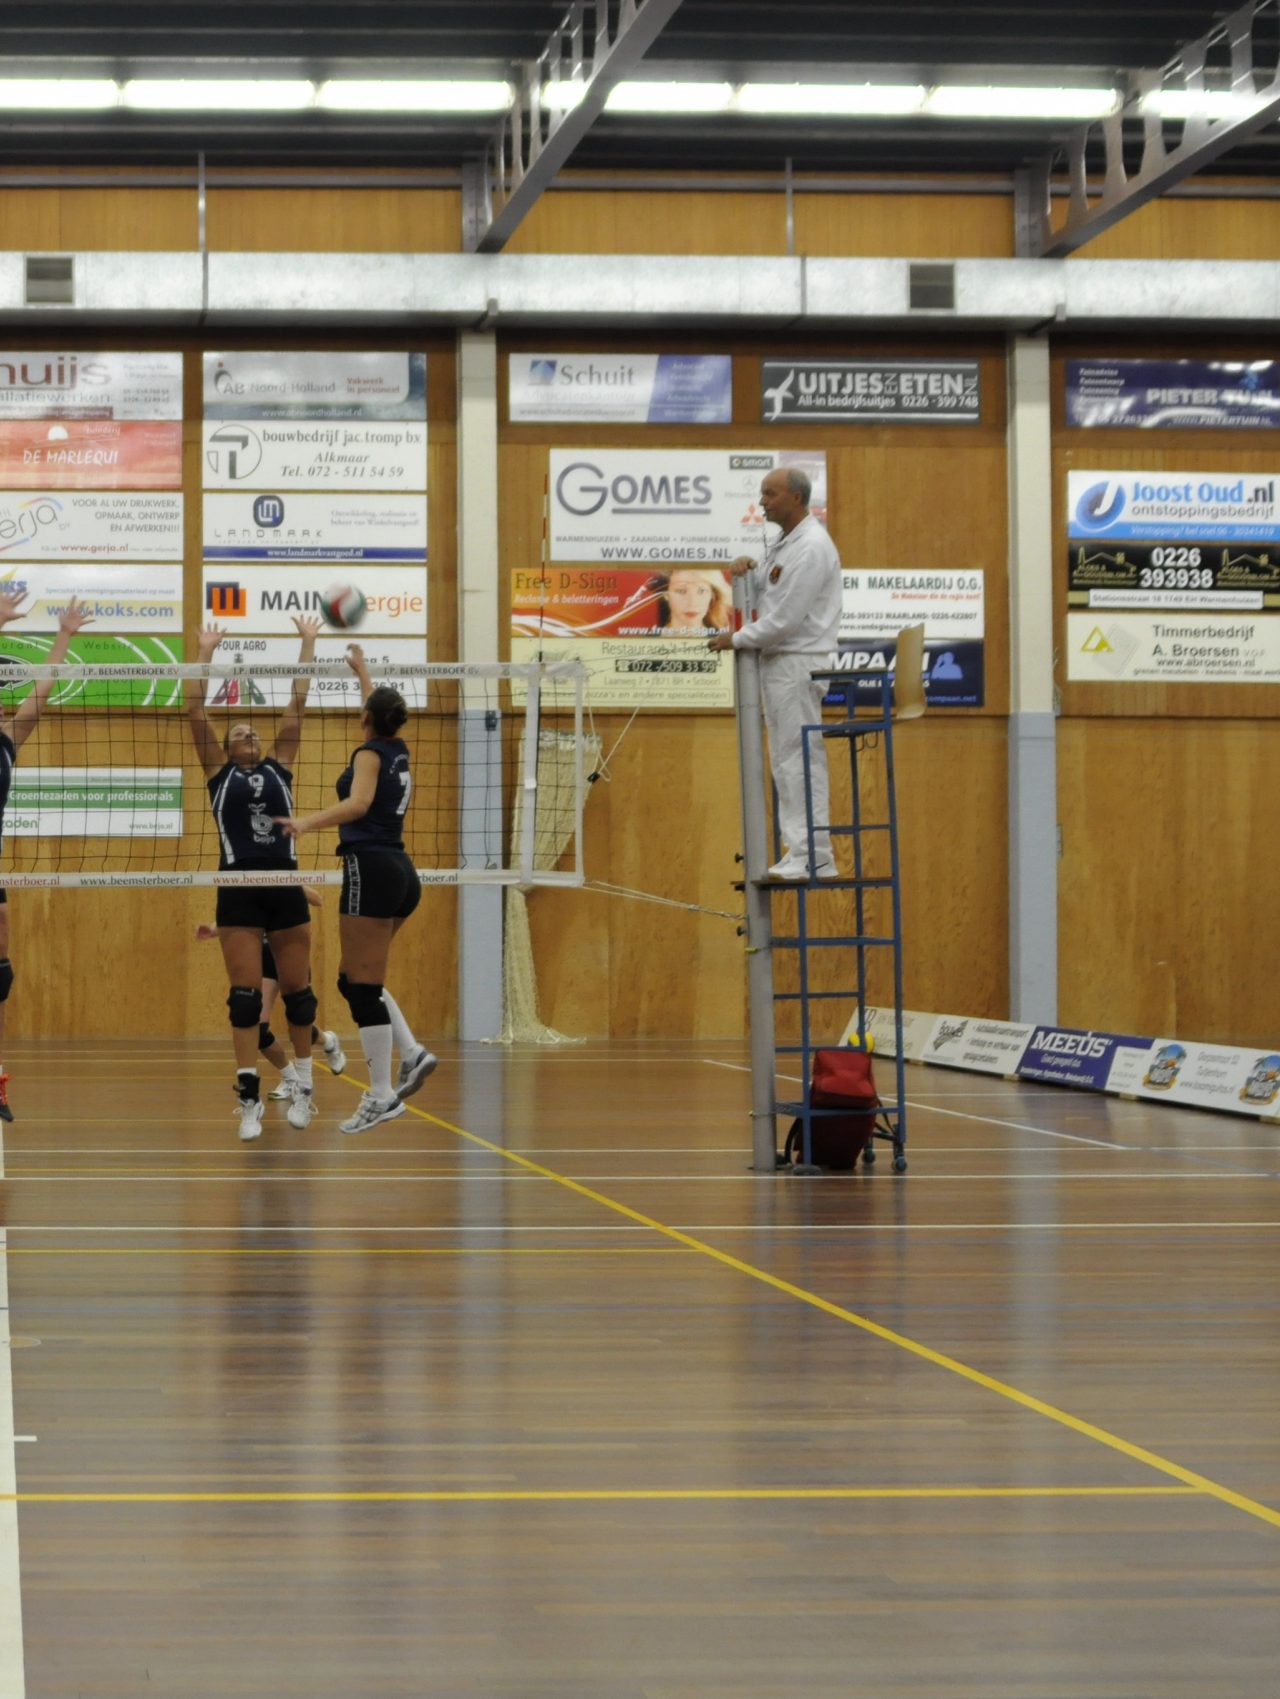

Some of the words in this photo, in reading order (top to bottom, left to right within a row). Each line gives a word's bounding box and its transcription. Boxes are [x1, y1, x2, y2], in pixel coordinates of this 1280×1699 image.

[560, 364, 635, 386] Schuit
[223, 382, 245, 395] AB
[798, 372, 883, 394] UITJES
[900, 374, 963, 395] ETEN
[1146, 388, 1218, 404] PIETER
[262, 430, 339, 447] bouwbedrijf
[314, 453, 370, 463] Alkmaar
[281, 466, 304, 477] Tel.
[308, 466, 331, 477] 072
[343, 467, 364, 477] 511
[370, 467, 385, 477] 54
[388, 467, 404, 477] 59
[556, 462, 712, 516] GOMES
[1132, 481, 1192, 503] Joost
[72, 499, 97, 508] VOOR
[100, 499, 110, 508] AL
[112, 499, 127, 508] UW
[138, 511, 179, 520] ONTWERP
[1132, 505, 1274, 519] ontstoppingsbedrijf
[110, 524, 122, 532] EN
[601, 547, 733, 559] WWW.GOMES.NL
[1151, 547, 1201, 567] 0226
[515, 573, 552, 589] Free
[560, 572, 618, 593] D-Sign
[868, 577, 953, 590] MAKELAARDIJ
[957, 578, 981, 590] O.G.
[1140, 568, 1214, 589] 393938
[260, 590, 423, 617] MAIergie
[1152, 625, 1255, 641] Timmerbedrijf
[218, 641, 240, 651] FOUR
[243, 641, 266, 651] AGRO
[1152, 644, 1167, 656] A.
[1173, 644, 1239, 656] Broersen
[99, 667, 165, 676] BEEMSTERBOER
[249, 667, 315, 675] BEEMSTERBOER
[632, 661, 652, 672] 072
[685, 661, 699, 672] 33
[701, 661, 715, 672] 99
[319, 682, 348, 691] 0226
[9, 790, 79, 802] Groentezaden
[82, 791, 103, 802] voor
[107, 791, 173, 804] professionals
[80, 874, 193, 887] www.beemsterboer.nl
[212, 873, 326, 886] www.beemsterboer.nl
